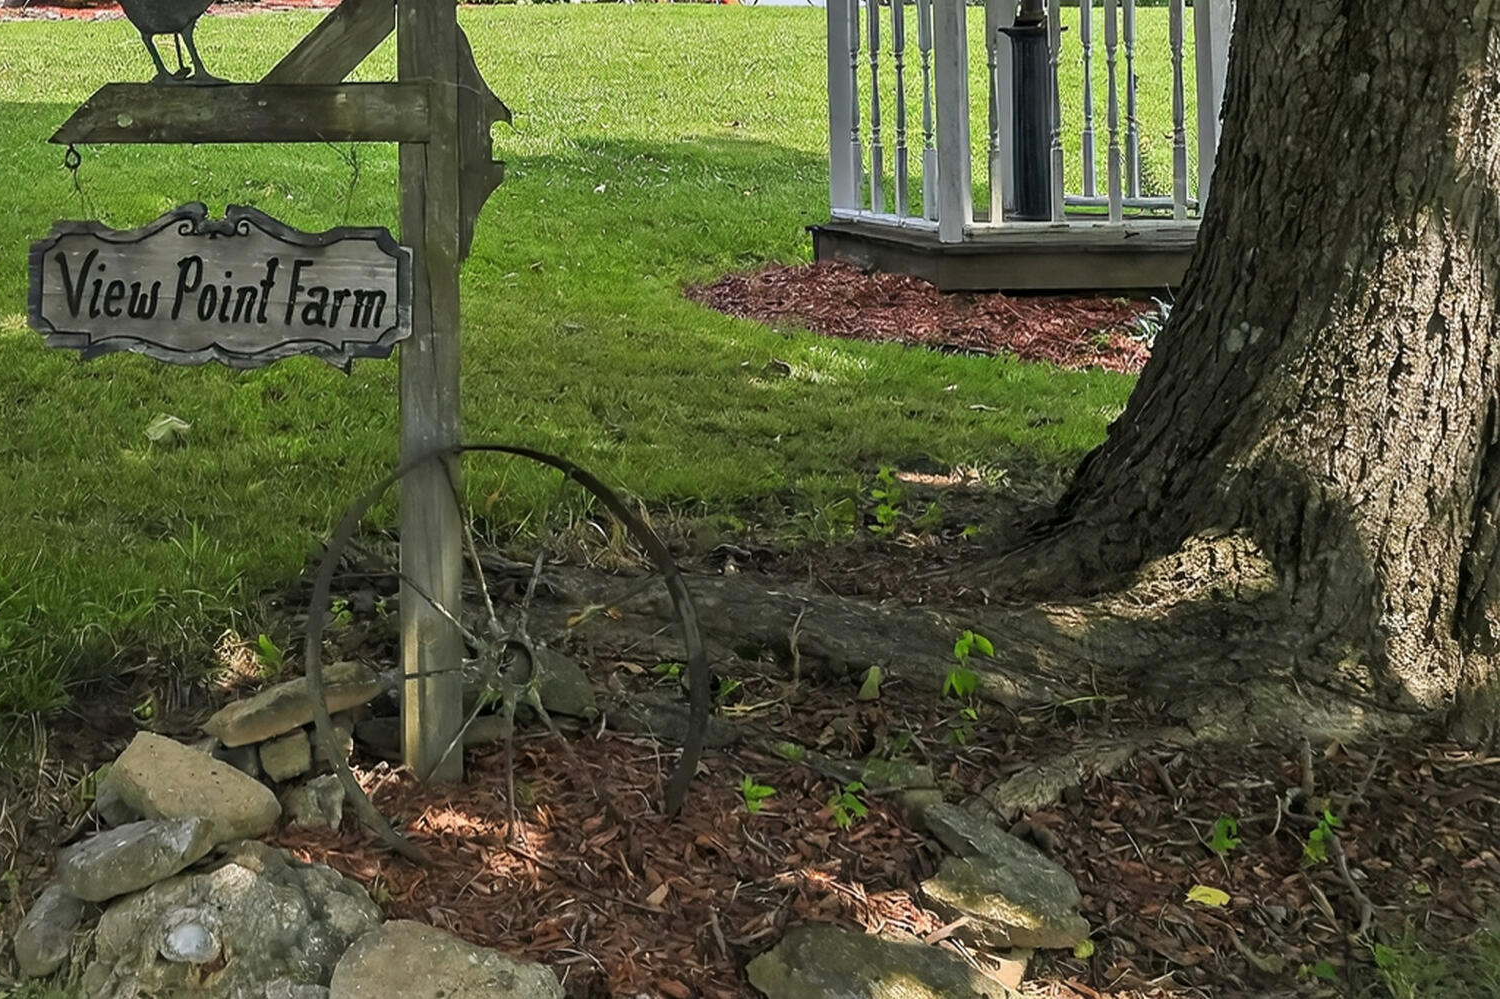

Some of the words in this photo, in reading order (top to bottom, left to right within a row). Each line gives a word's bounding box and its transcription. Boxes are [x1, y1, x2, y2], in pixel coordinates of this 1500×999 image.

[54, 248, 161, 320] View
[171, 254, 279, 324] Point
[285, 259, 387, 328] Farm
